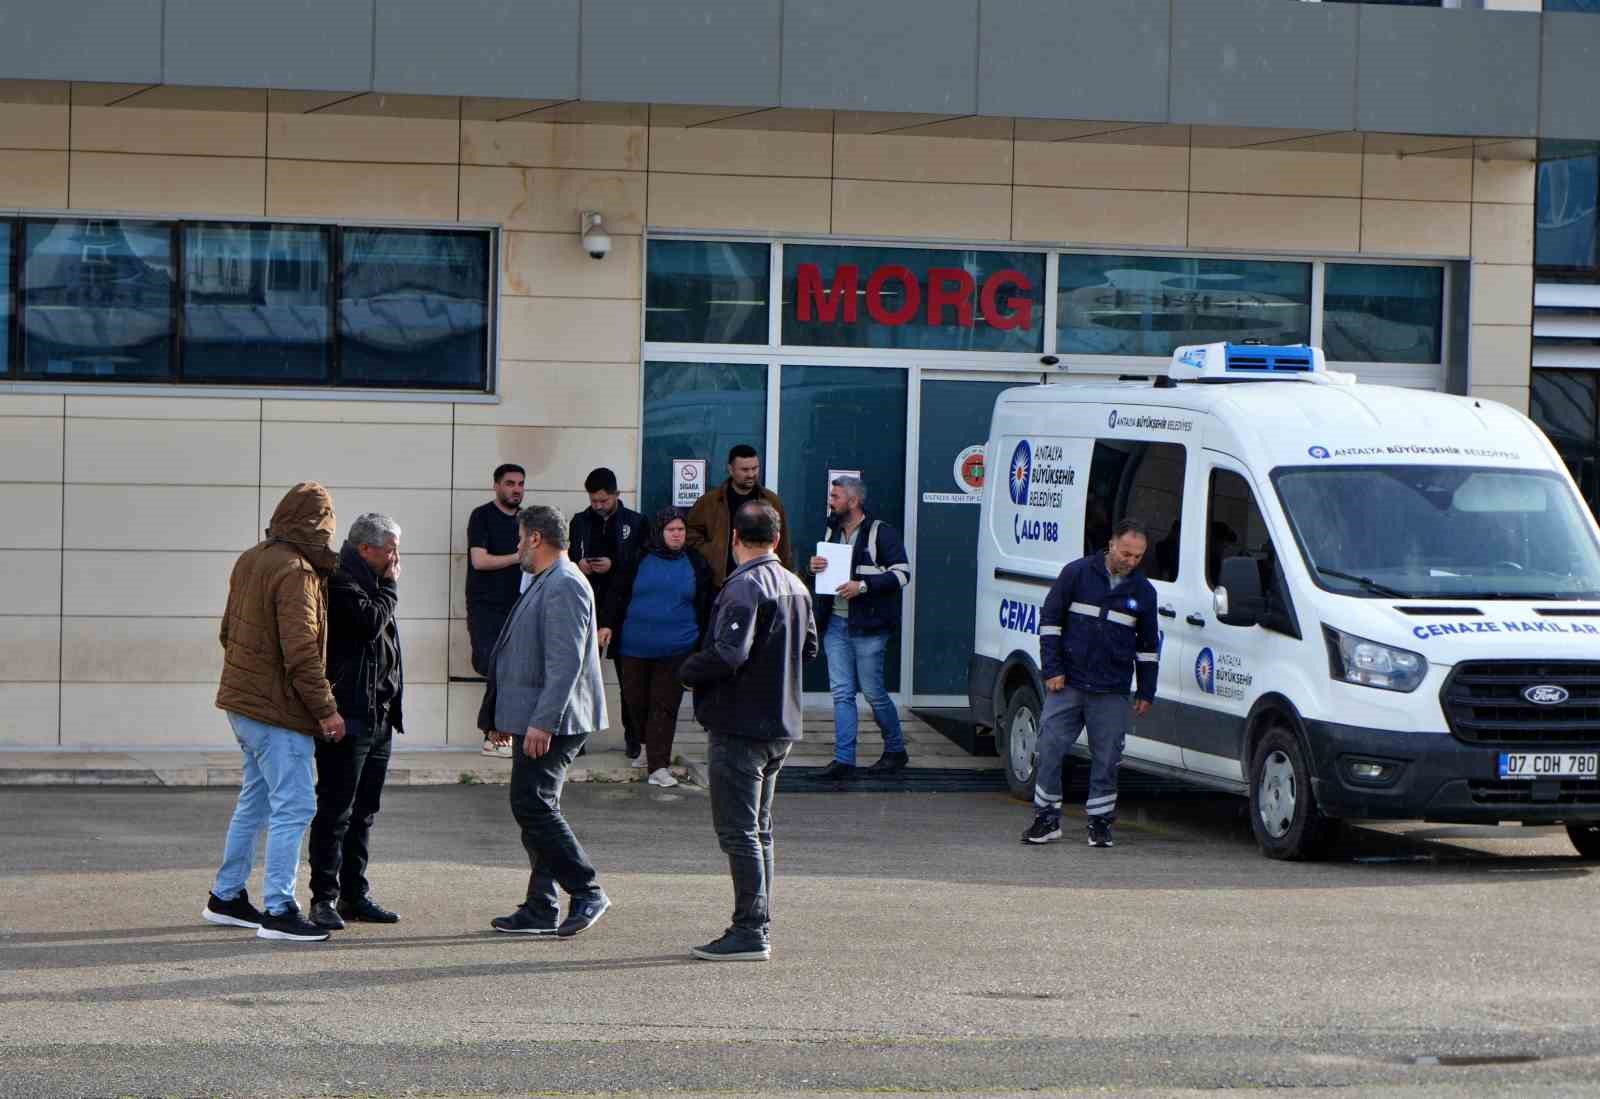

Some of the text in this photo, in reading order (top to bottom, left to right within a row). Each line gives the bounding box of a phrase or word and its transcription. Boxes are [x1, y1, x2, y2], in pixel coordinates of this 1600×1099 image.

[796, 263, 1034, 332] MORG
[1034, 445, 1063, 461] ANTALYA
[1334, 447, 1385, 457] ANTALYA
[1386, 444, 1460, 456] BÜYÜKŞEHİR
[1031, 465, 1075, 487] BÜYÜKŞEHİR
[1029, 489, 1064, 508] BELEDİYESİ
[1021, 520, 1058, 542] ALO 188
[999, 598, 1040, 635] CENA
[1413, 622, 1500, 640] CENAZE
[1532, 687, 1561, 701] Ford
[1508, 756, 1595, 772] 07 CDH 780
